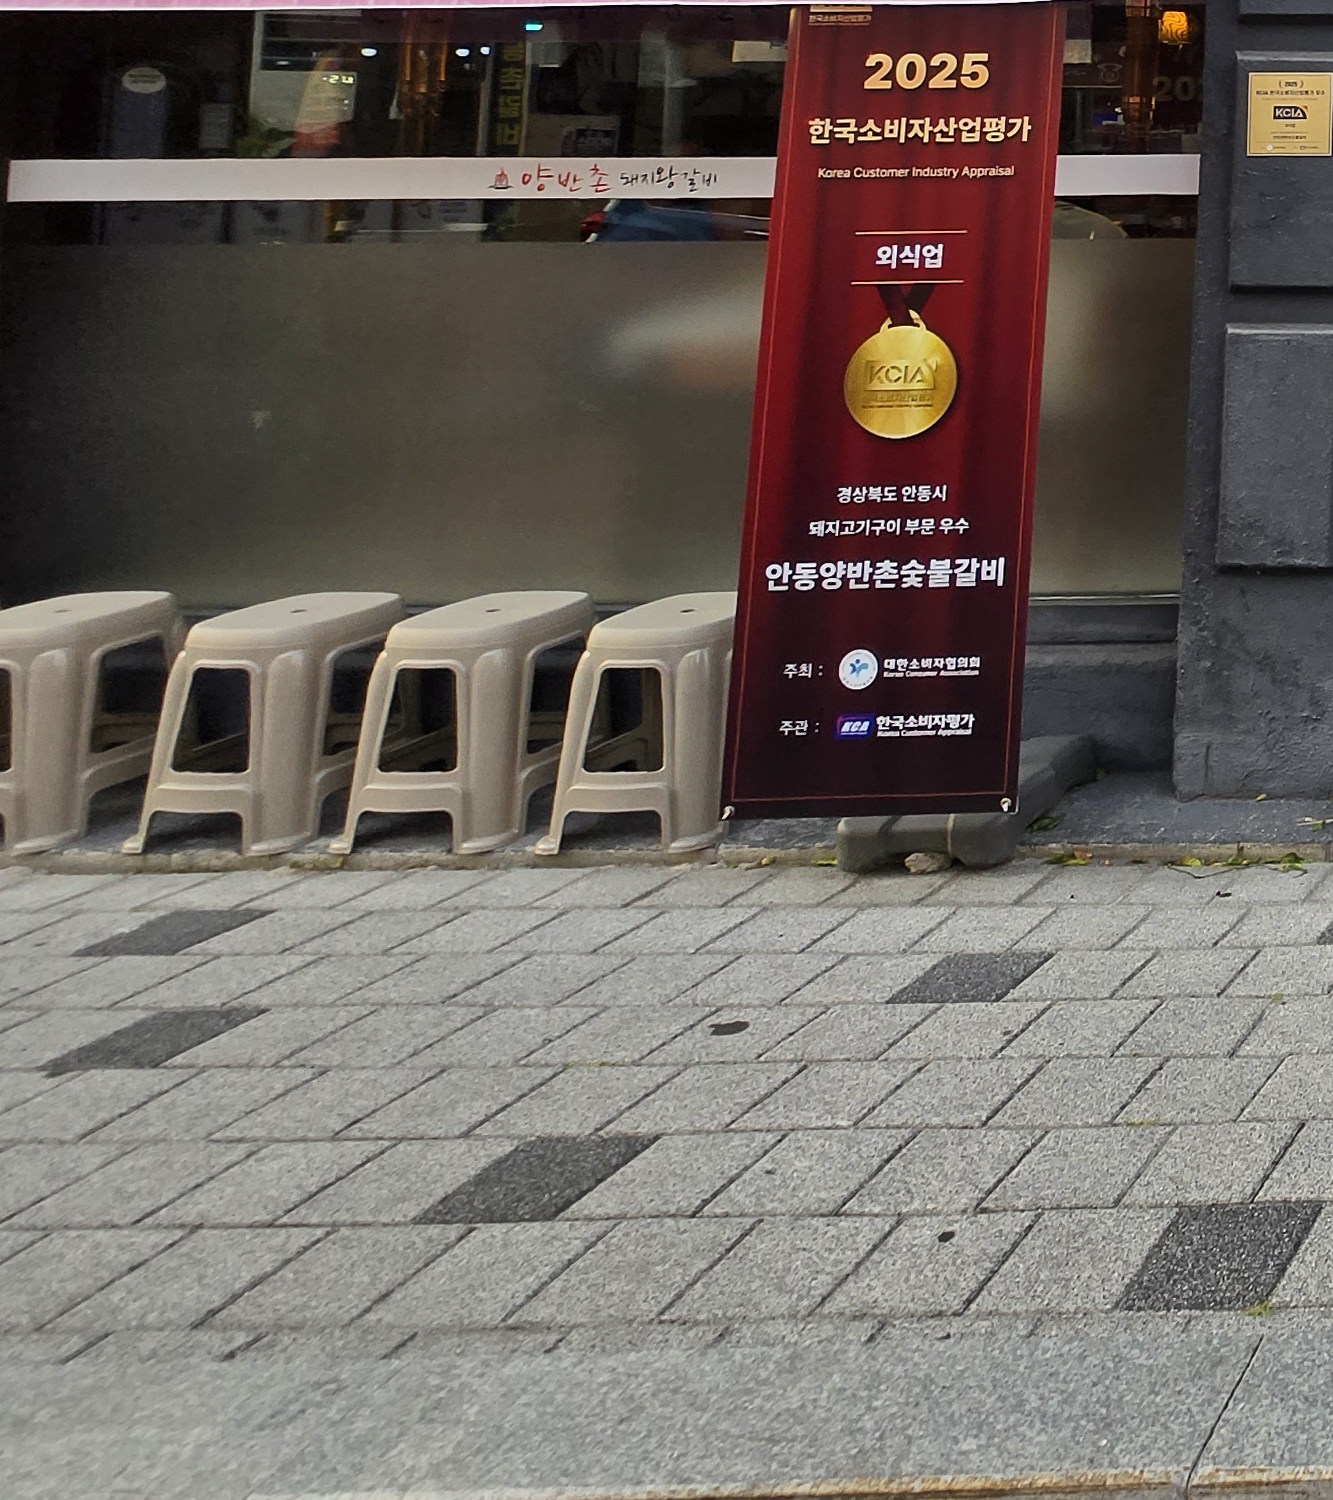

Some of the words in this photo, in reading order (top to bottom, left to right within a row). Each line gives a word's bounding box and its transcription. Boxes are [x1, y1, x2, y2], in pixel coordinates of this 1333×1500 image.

[863, 52, 990, 90] 2025
[1275, 108, 1304, 118] KCIA
[808, 116, 1032, 144] 한국소비자산업평가
[522, 163, 612, 194] 양반촌
[620, 166, 718, 193] 돼지왕갈비
[818, 167, 850, 178] Korea
[853, 166, 909, 178] Customer
[912, 166, 959, 180] Industry
[961, 165, 1015, 179] Appraisal
[875, 243, 944, 269] 외식업
[869, 365, 925, 384] KCIA
[836, 486, 898, 503] 경상북도
[900, 484, 948, 503] 안동시
[808, 518, 900, 538] 돼지고기구이
[904, 517, 936, 536] 부문
[938, 517, 970, 535] 우수
[764, 556, 1006, 592] 안동양반촌숯불갈비
[782, 663, 813, 679] 주최
[778, 720, 809, 736] 주관
[876, 713, 976, 731] 한국소비자평가
